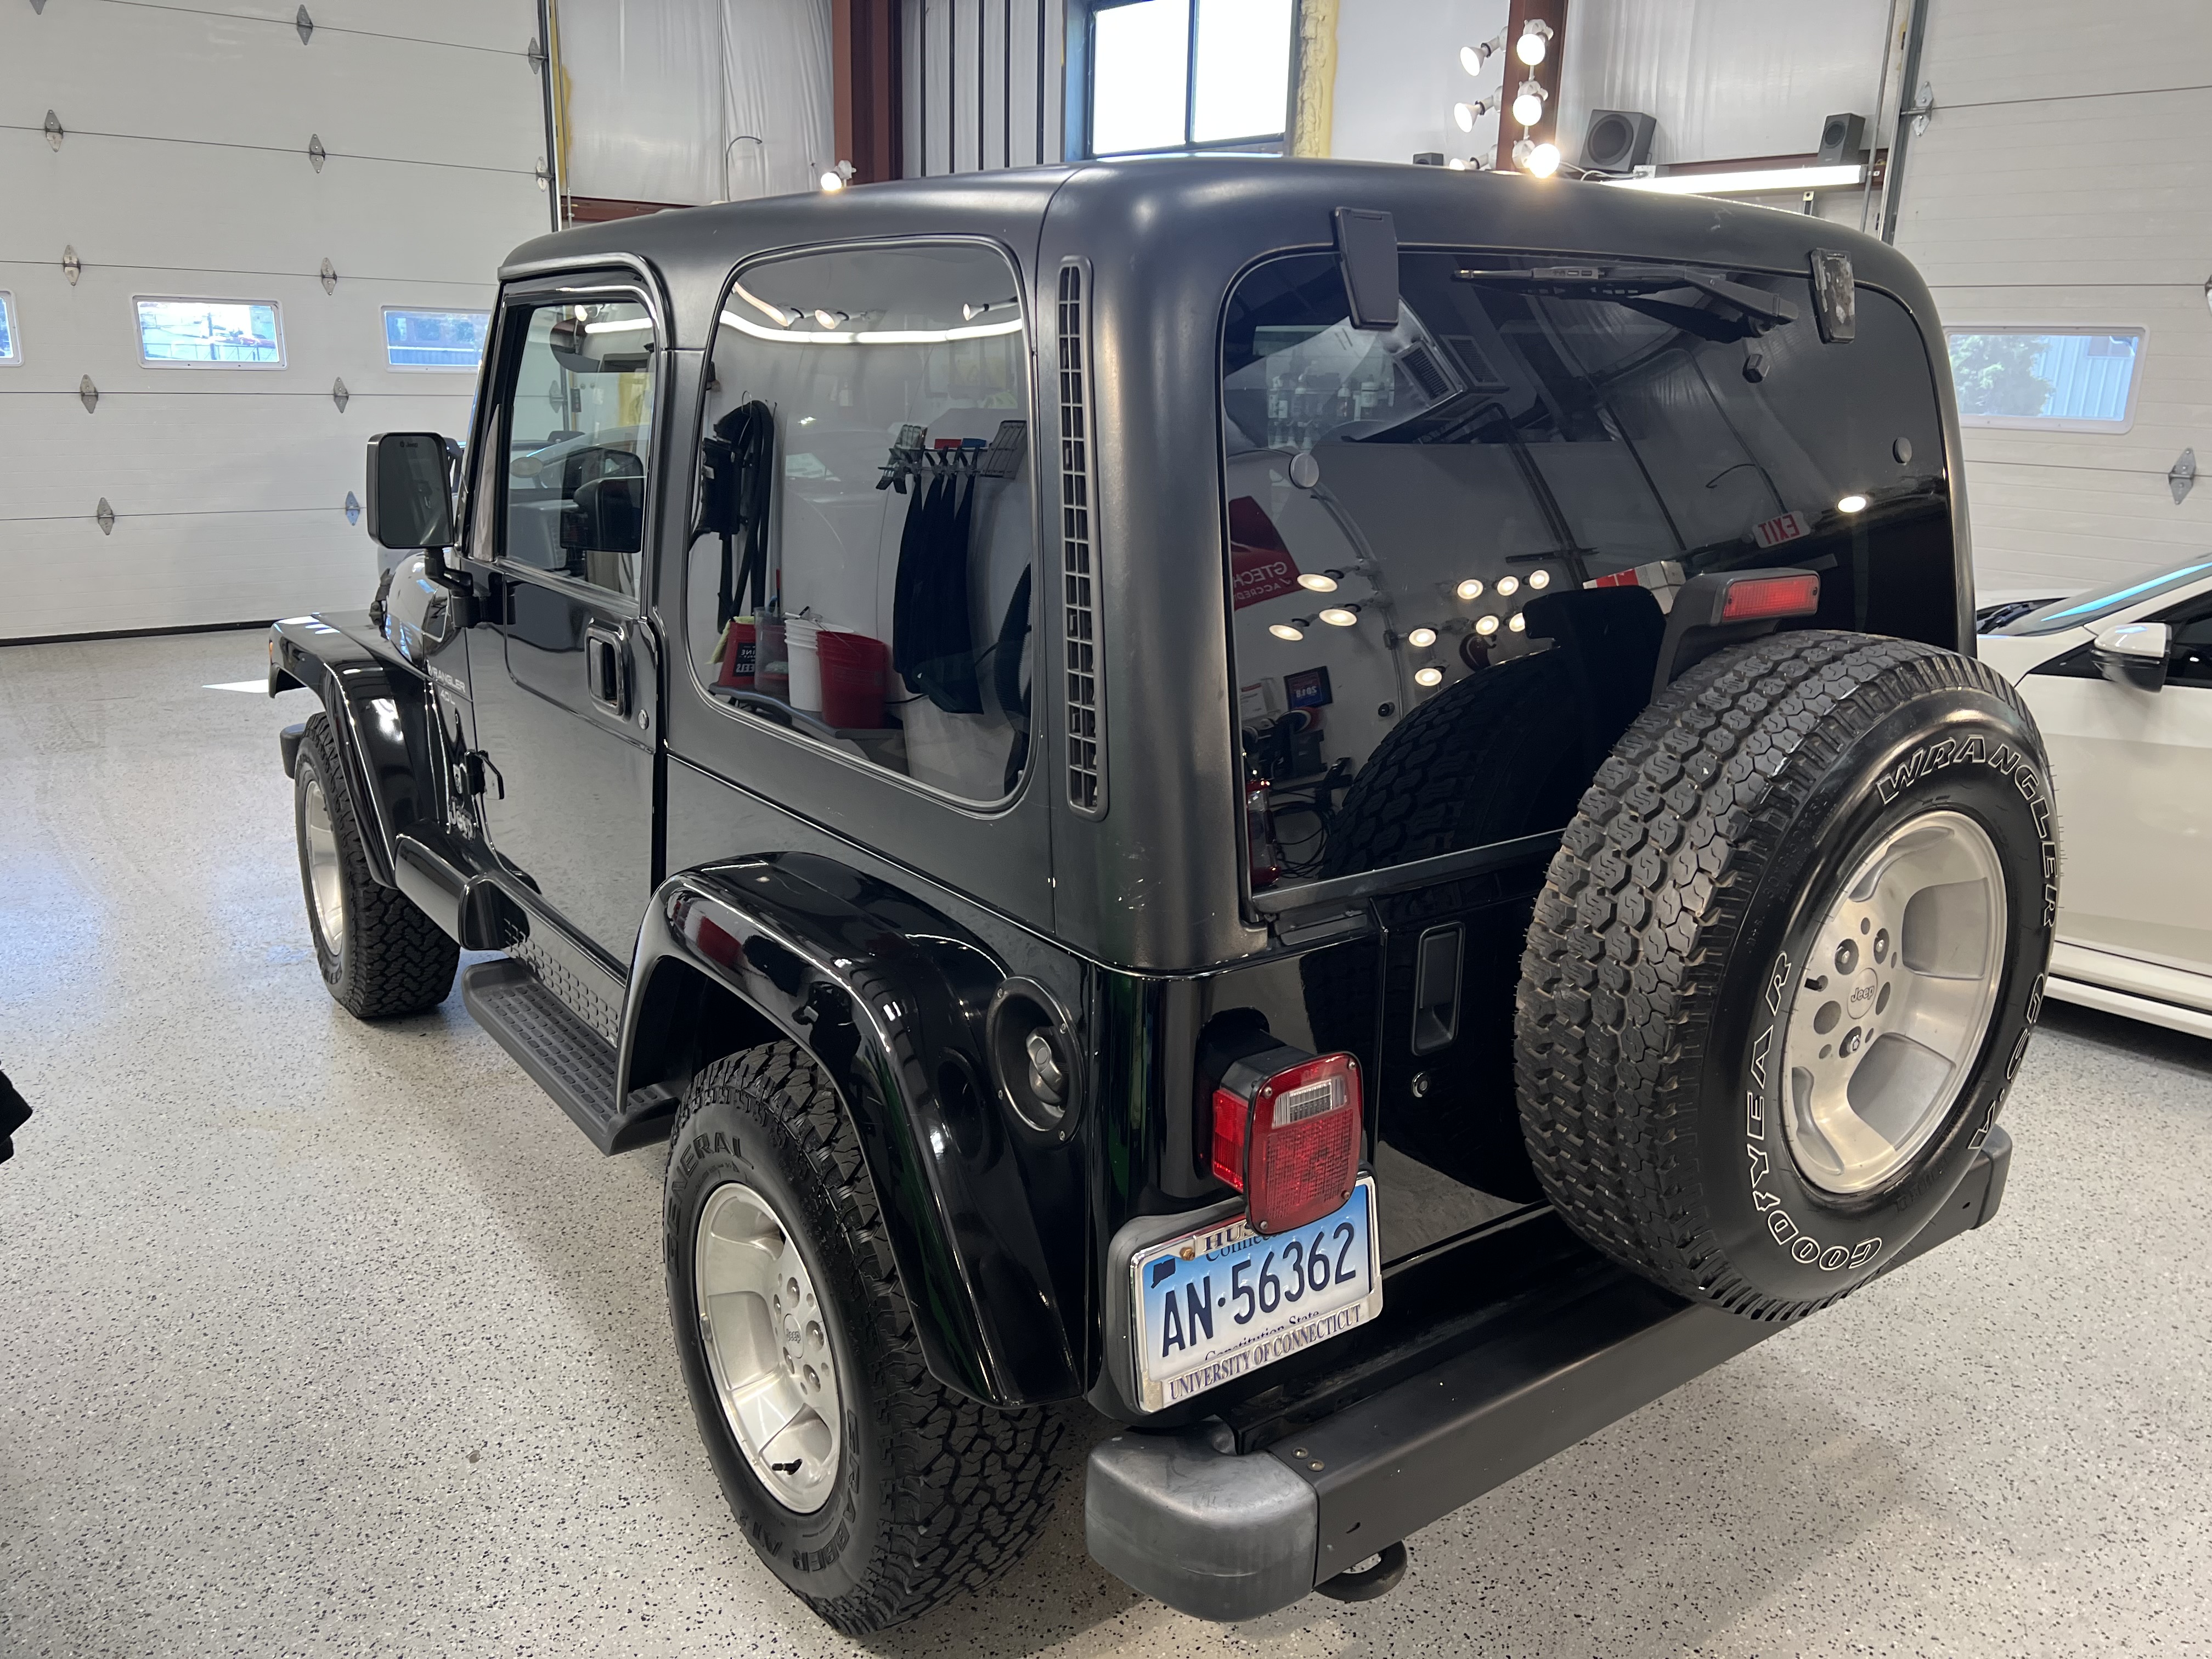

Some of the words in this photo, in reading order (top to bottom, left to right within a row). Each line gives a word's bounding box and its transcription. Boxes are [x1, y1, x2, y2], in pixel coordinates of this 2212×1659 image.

[425, 658, 466, 693] WRANGLER
[1875, 734, 2058, 928] WRANGLER
[1850, 985, 1875, 1003] Jeep
[1746, 951, 1882, 1271] GOODYEAR
[667, 1132, 754, 1279] GENERAL
[786, 1328, 802, 1344] Jeep
[1168, 1348, 1251, 1400] UNIVERSITY
[1252, 1340, 1271, 1365] OF
[1273, 1303, 1361, 1357] CONNECTICUT
